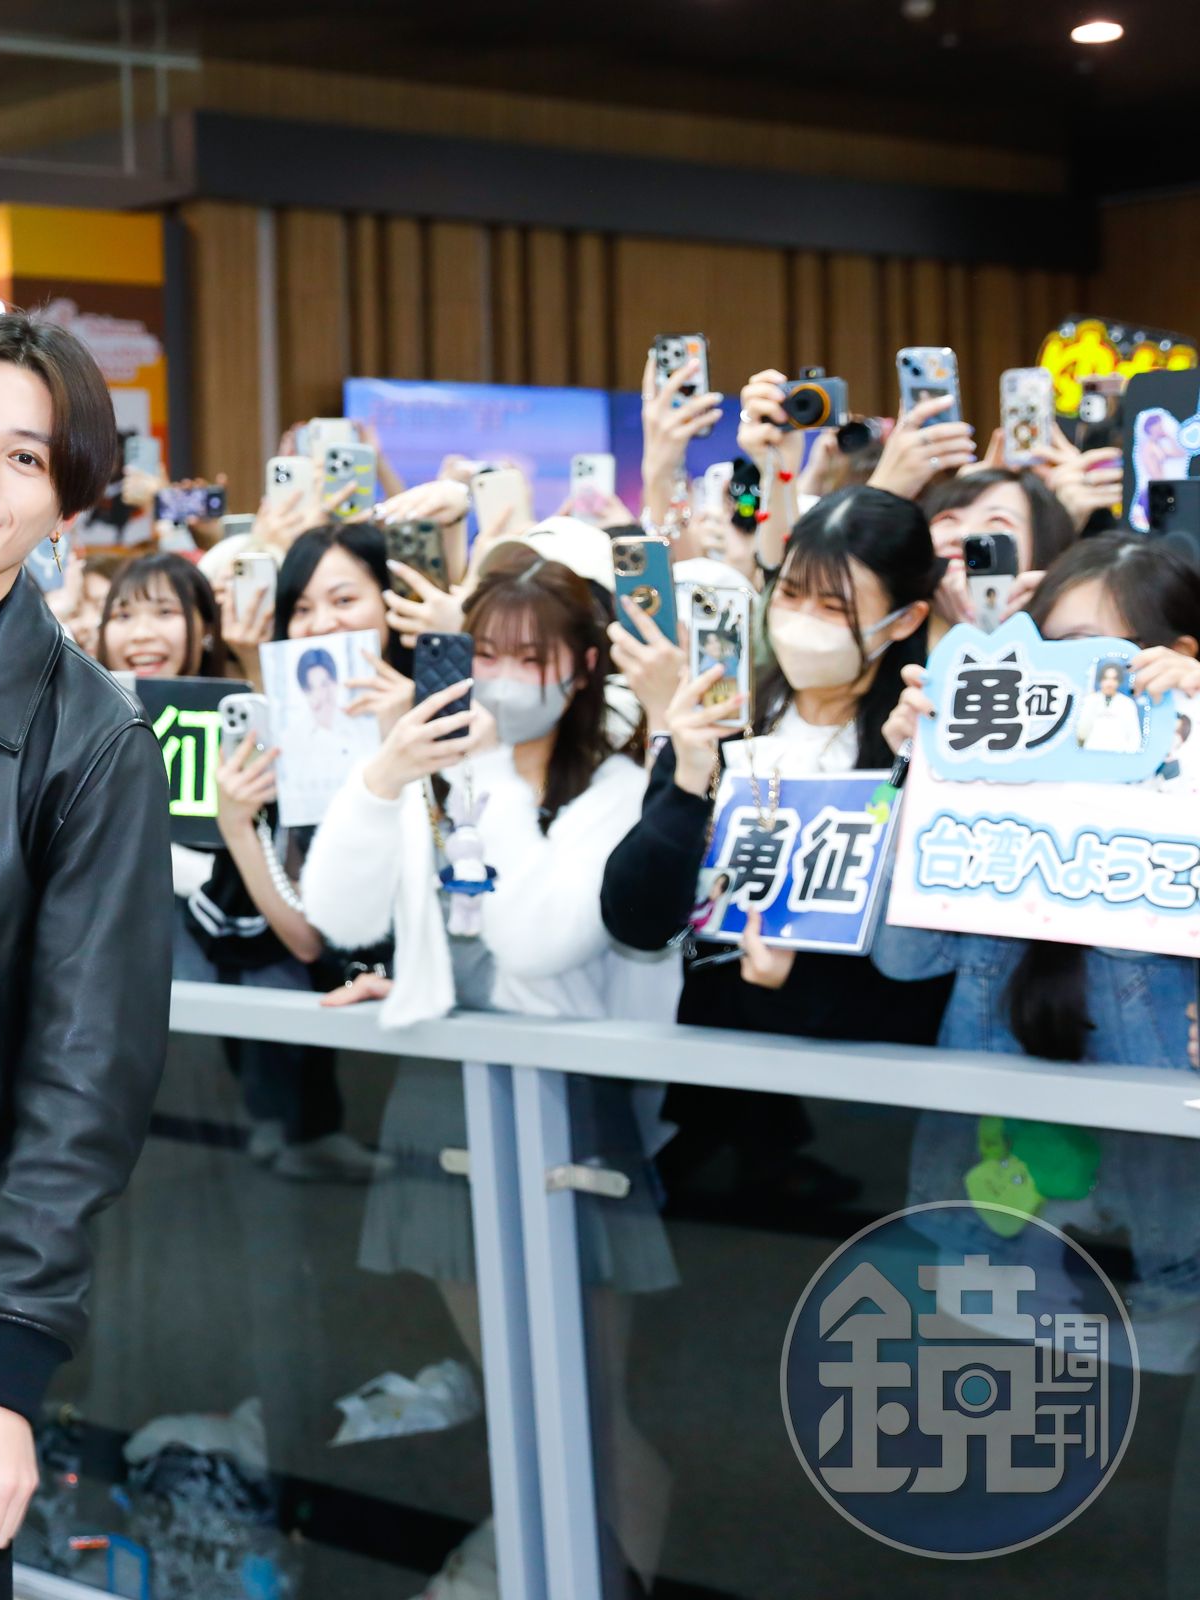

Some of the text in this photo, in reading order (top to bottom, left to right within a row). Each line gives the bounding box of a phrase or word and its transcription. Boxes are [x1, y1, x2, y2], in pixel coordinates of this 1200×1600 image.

[948, 669, 1059, 751] 勇征
[727, 812, 877, 906] 勇征
[920, 815, 1200, 908] 台湾へようこ
